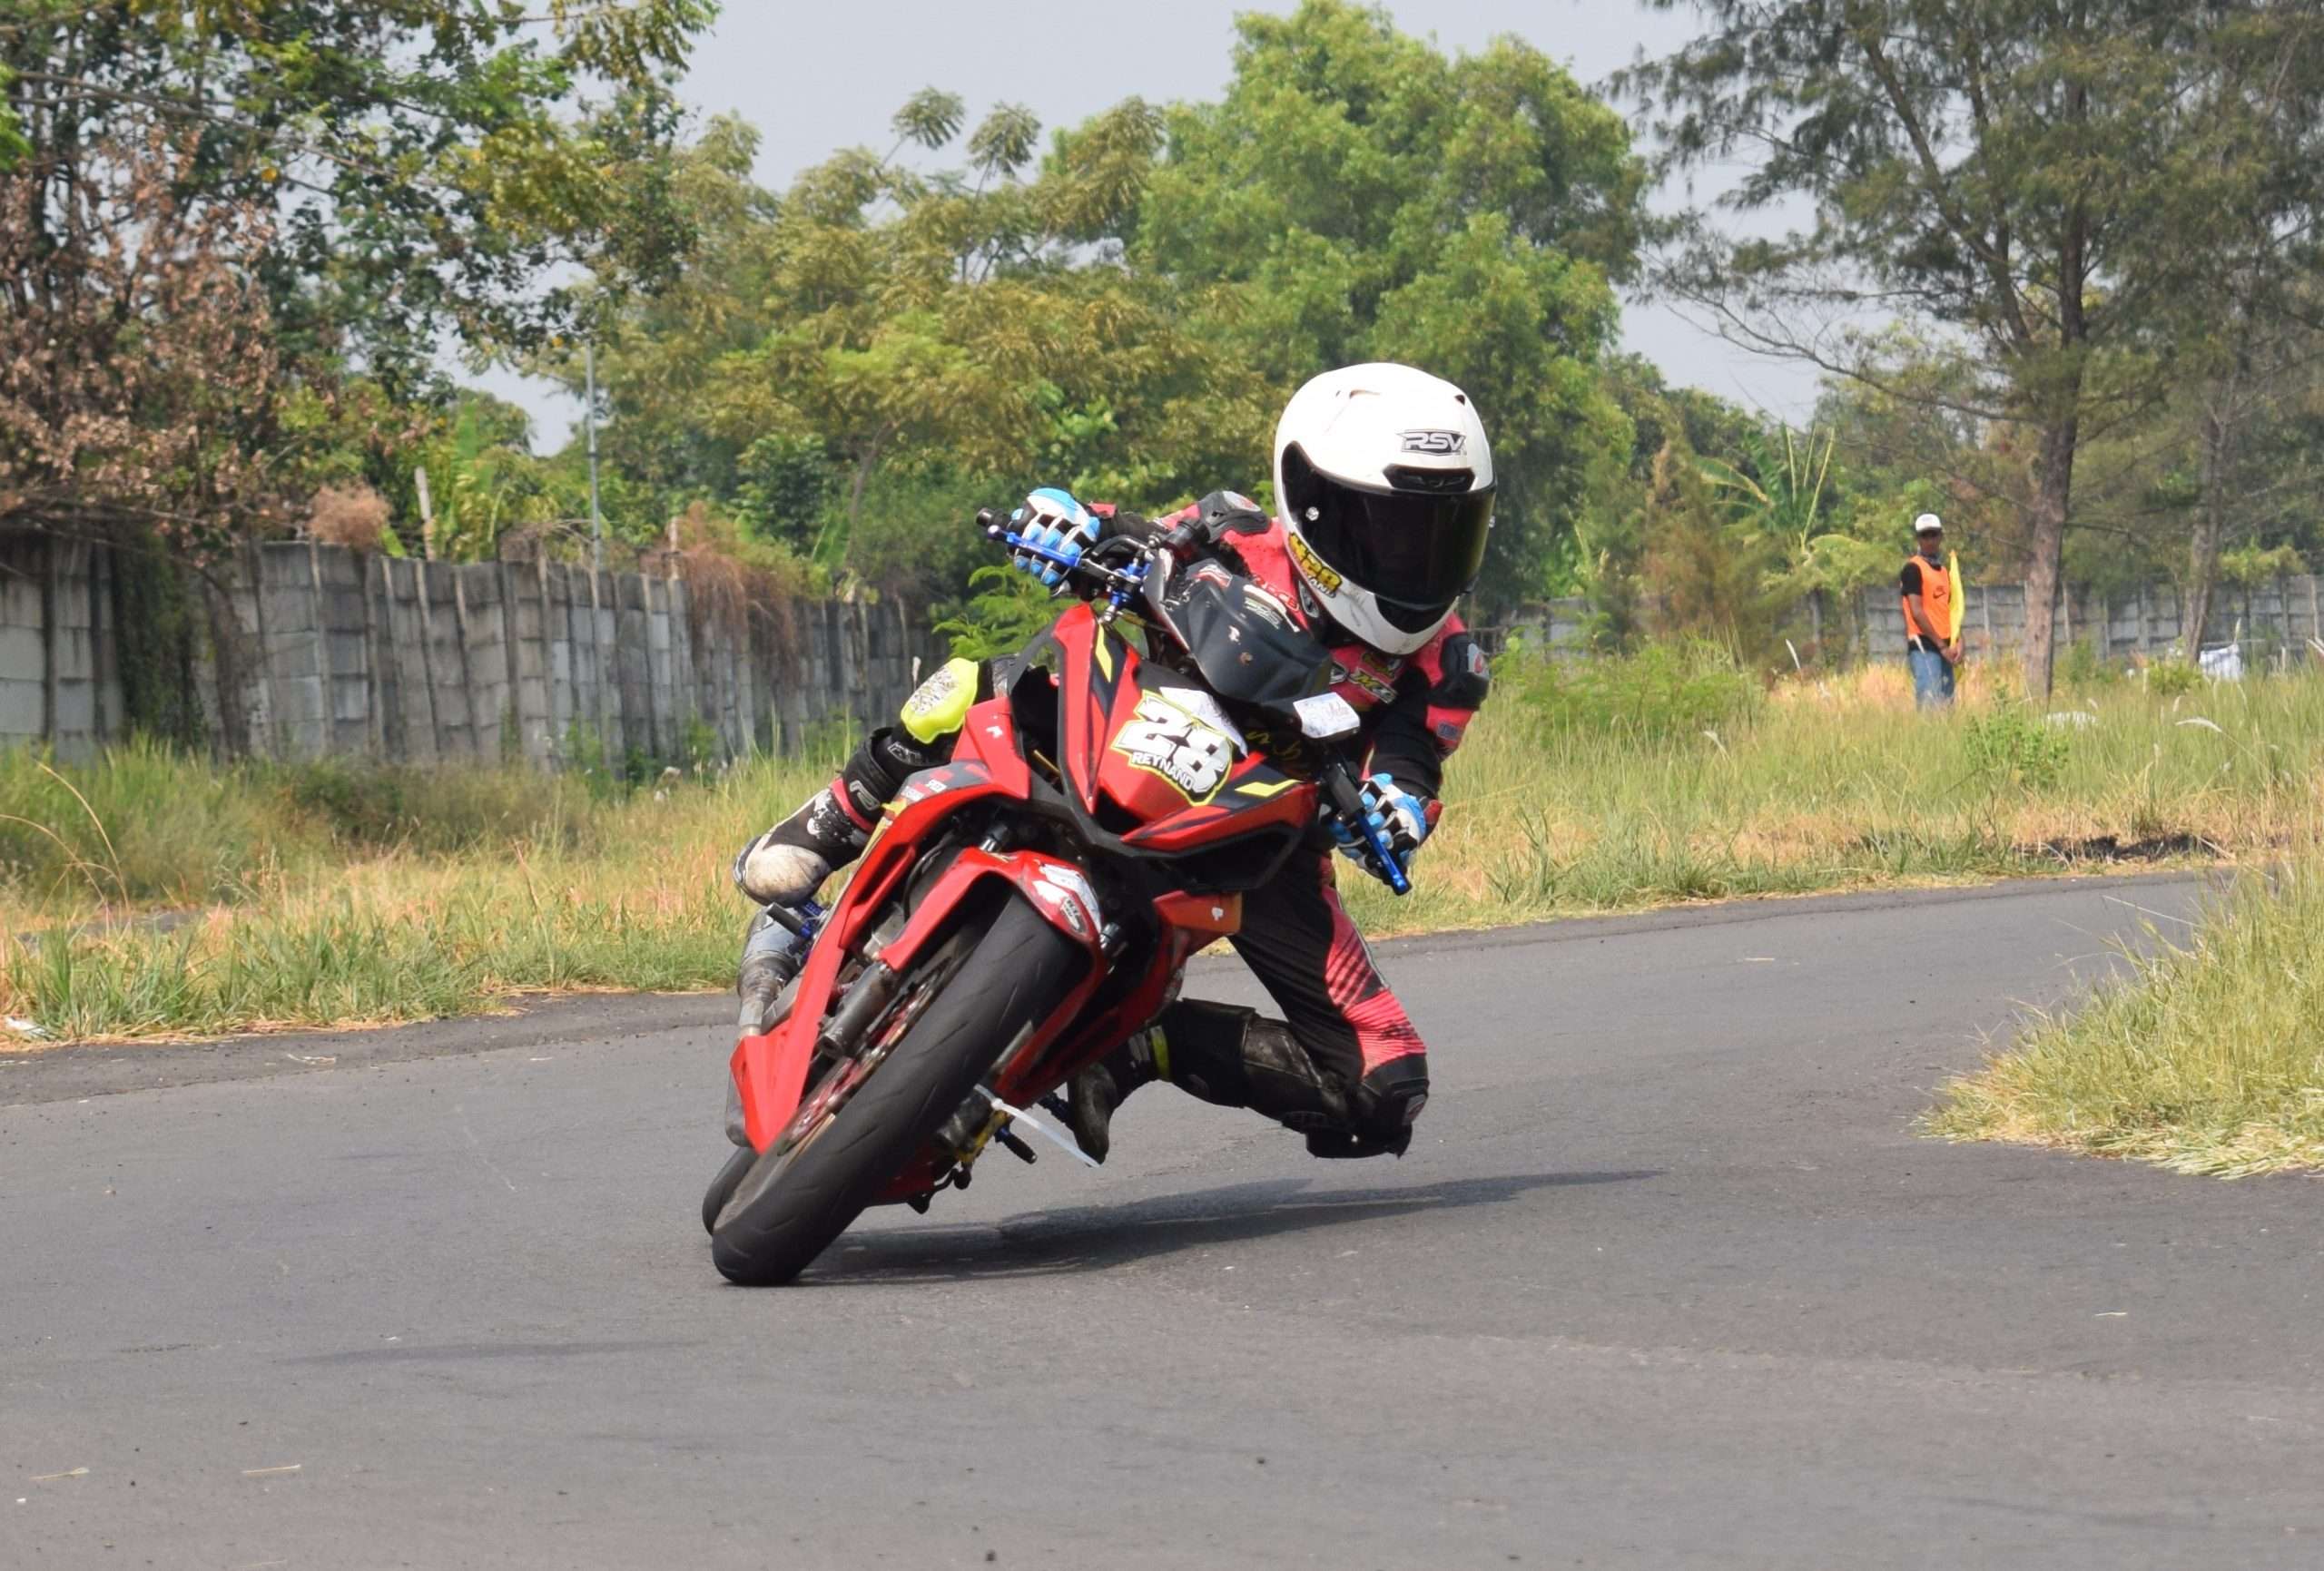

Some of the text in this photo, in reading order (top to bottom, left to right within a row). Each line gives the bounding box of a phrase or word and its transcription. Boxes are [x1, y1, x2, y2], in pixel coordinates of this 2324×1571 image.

[1405, 432, 1465, 451] RSV
[1116, 696, 1231, 794] 28
[1131, 751, 1195, 790] REYNAND
